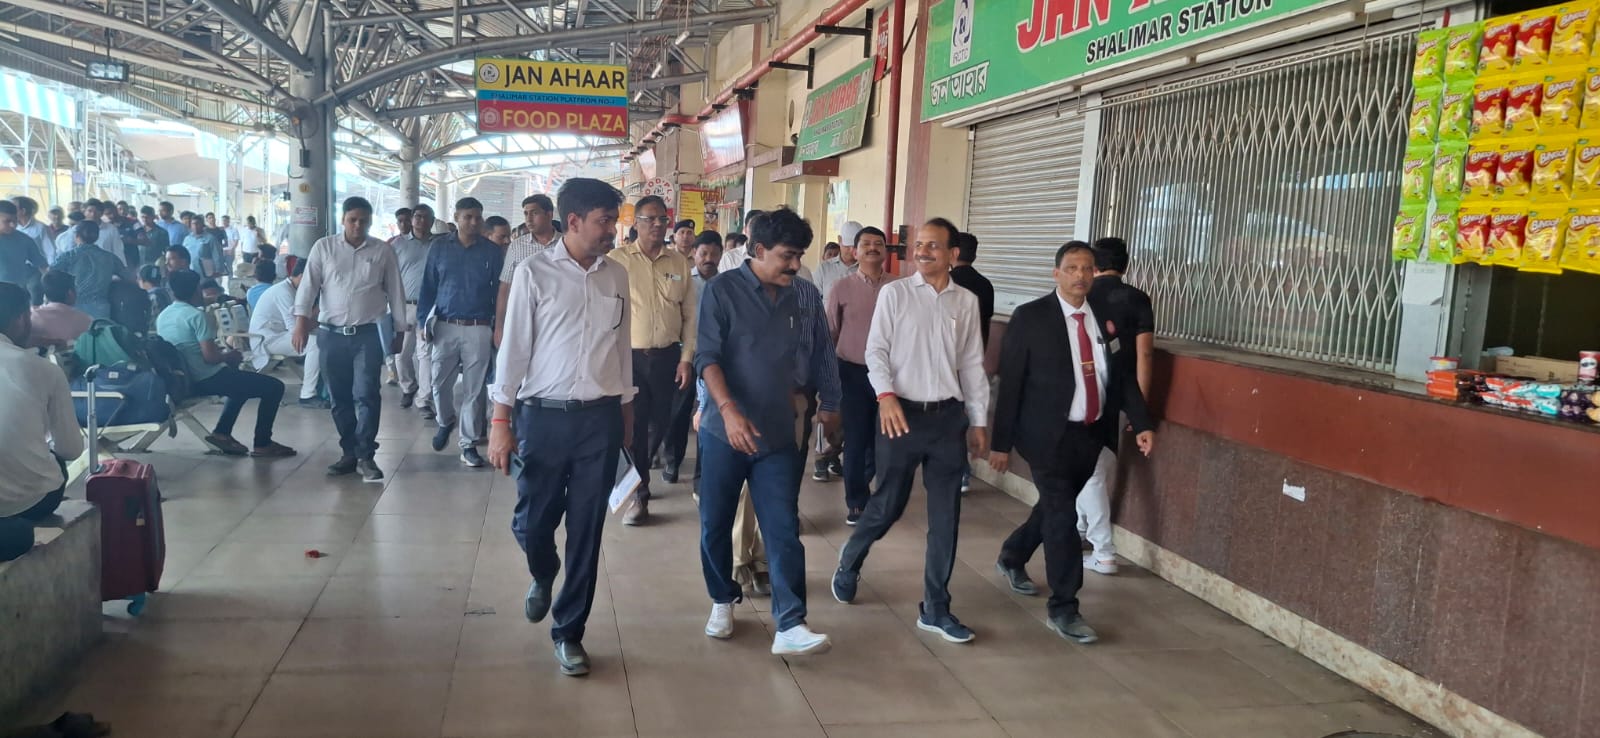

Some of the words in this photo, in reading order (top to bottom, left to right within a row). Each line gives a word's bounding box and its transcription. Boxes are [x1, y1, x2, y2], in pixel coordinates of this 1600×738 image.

[1086, 15, 1172, 63] SHALIMAR
[504, 64, 543, 88] JAN
[549, 67, 625, 90] AHAAR
[930, 76, 949, 106] জন
[950, 61, 990, 99] আহার
[503, 109, 561, 129] FOOD
[566, 112, 625, 132] PLAZA
